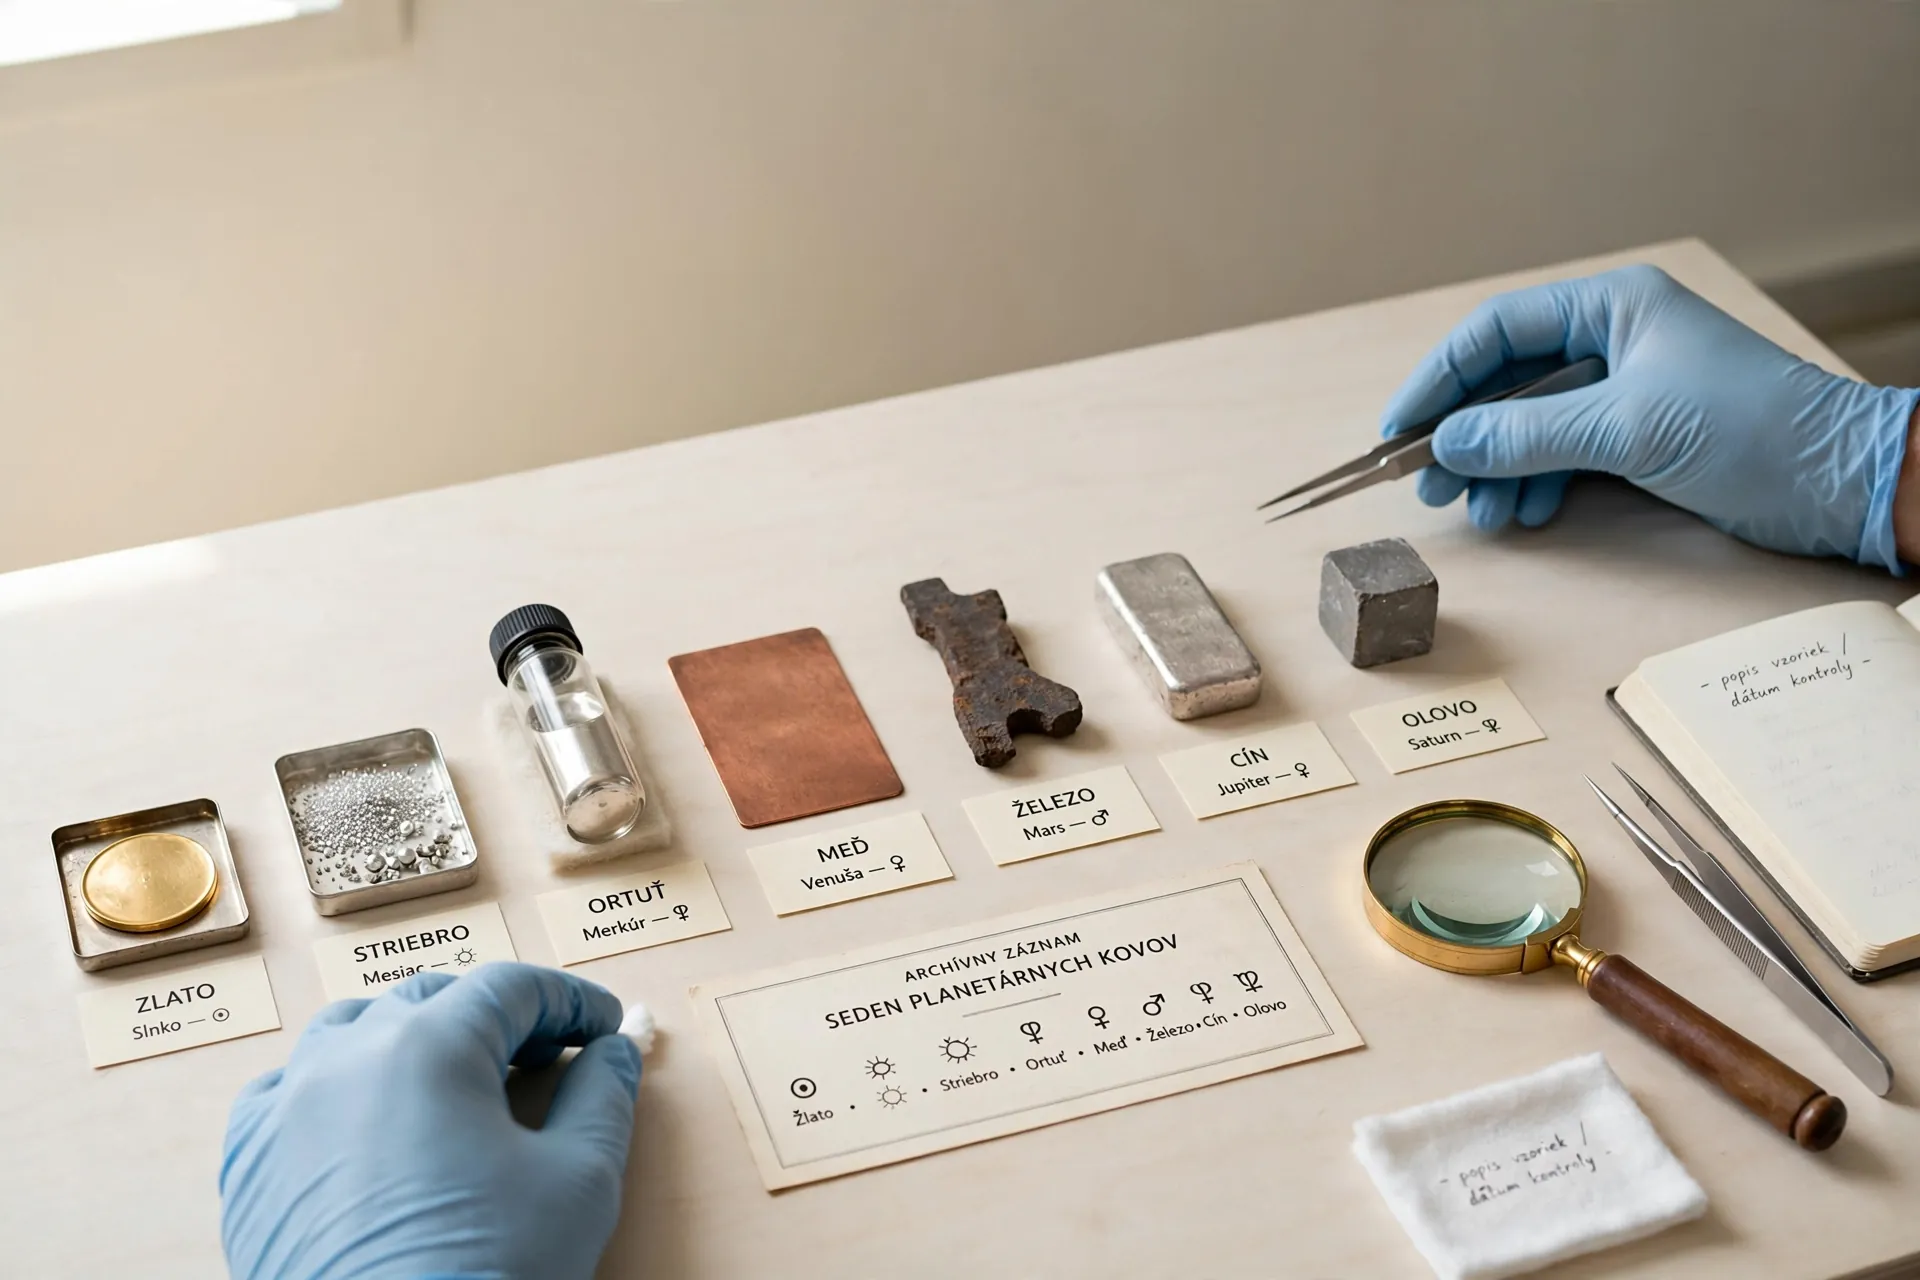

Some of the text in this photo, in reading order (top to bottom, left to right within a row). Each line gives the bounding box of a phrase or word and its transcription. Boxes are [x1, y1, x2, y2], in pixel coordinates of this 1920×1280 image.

[1721, 664, 1759, 692] popis
[1771, 641, 1829, 668] vzoriek
[1731, 685, 1781, 708] dátum
[1789, 659, 1853, 688] kontroly
[1401, 699, 1478, 728] OLOVO
[1407, 731, 1463, 751] Saturn
[1230, 746, 1270, 768] CÍN
[1217, 775, 1271, 797] Jupiter
[1011, 787, 1096, 819] ŽELEZO
[1022, 823, 1066, 841] Mars
[816, 835, 869, 863] MEĎ
[800, 867, 865, 891] Venuša
[588, 880, 666, 914] ORTUŤ
[353, 924, 470, 963] STRIEBRO
[582, 917, 646, 942] Merkúr
[905, 931, 1082, 983] ARCHÍVNY ZÁZNAM
[824, 933, 1177, 1030] SEDEN PLANETÁRNYCH KOVOV
[135, 983, 216, 1014] ZLATO
[132, 1020, 182, 1041] Slnko
[939, 1070, 999, 1092] Striebro
[1025, 1049, 1068, 1071] Ortuť
[1092, 1034, 1129, 1055] Meď
[1145, 1023, 1195, 1043] Železo
[1202, 1012, 1229, 1028] Cín
[1243, 1000, 1287, 1018] Olovo
[1459, 1162, 1501, 1186] popis
[1512, 1134, 1568, 1163] vzoriek
[1527, 1154, 1597, 1184] kontroly
